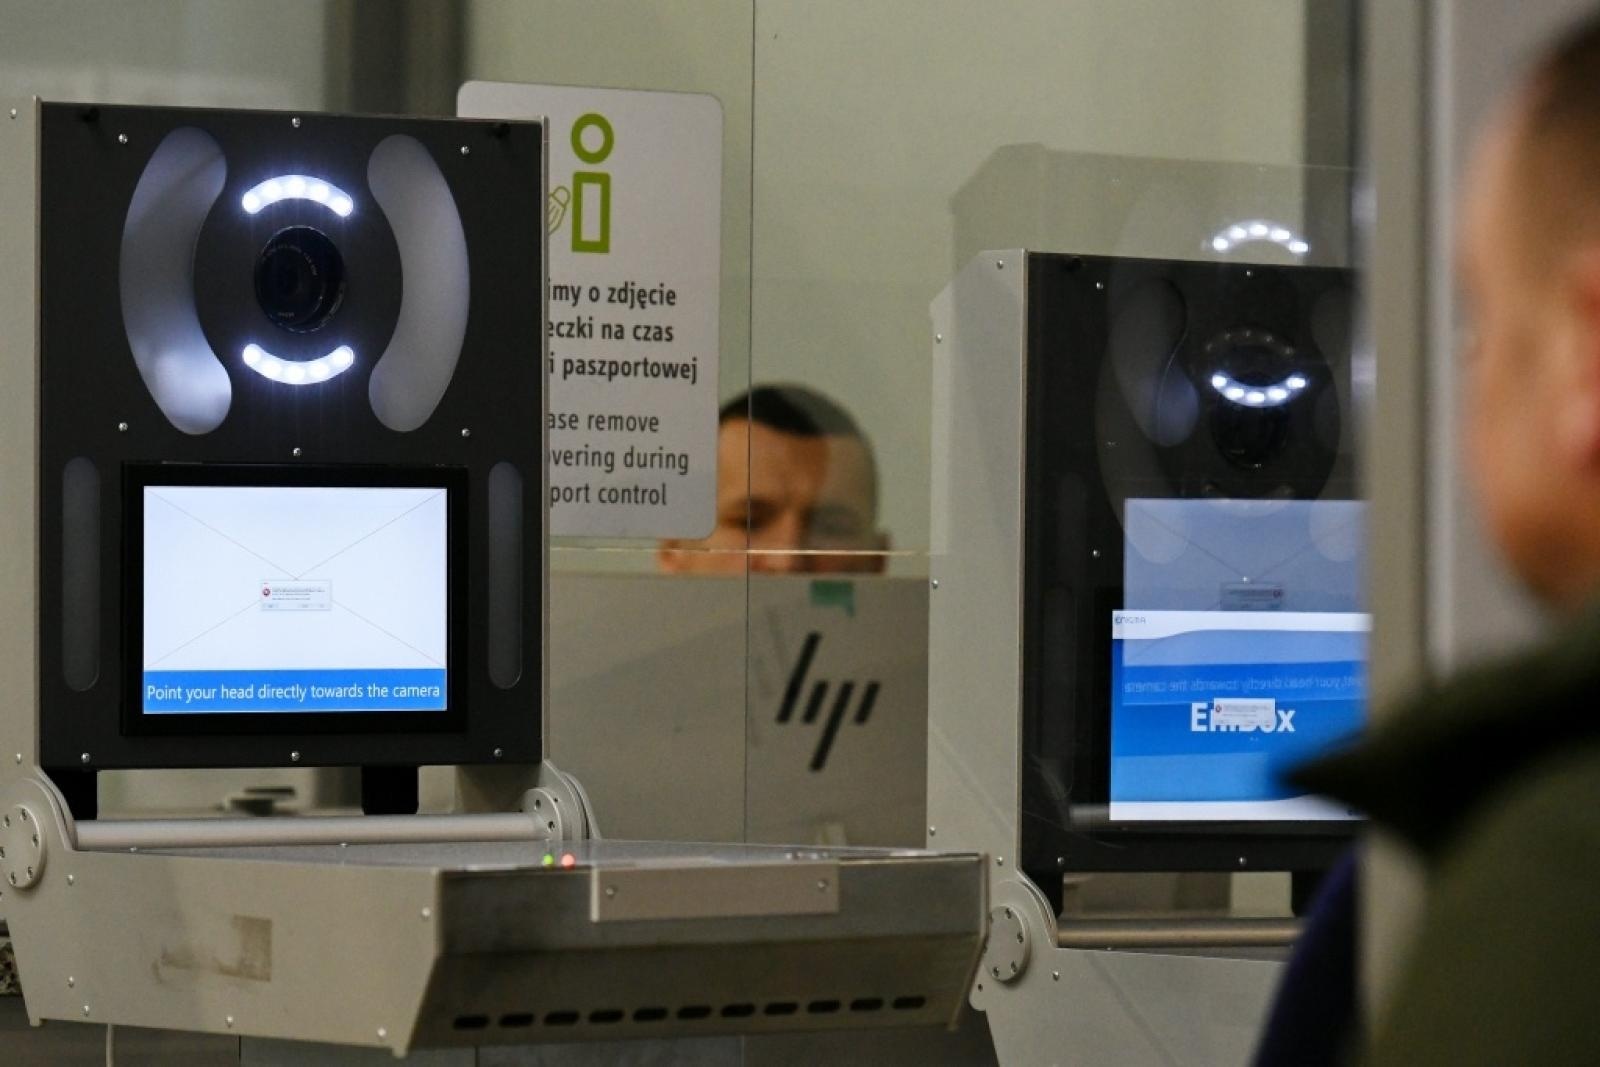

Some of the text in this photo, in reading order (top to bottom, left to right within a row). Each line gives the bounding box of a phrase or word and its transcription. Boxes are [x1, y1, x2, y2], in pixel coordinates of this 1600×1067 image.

[588, 285, 601, 303] o
[607, 280, 677, 309] zdjęcie
[601, 323, 625, 340] na
[632, 324, 674, 342] czas
[563, 356, 698, 385] paszportowej
[587, 414, 660, 432] remove
[548, 443, 689, 475] vering during
[550, 482, 667, 508] port control
[147, 683, 440, 704] Point your head directly towards the camera
